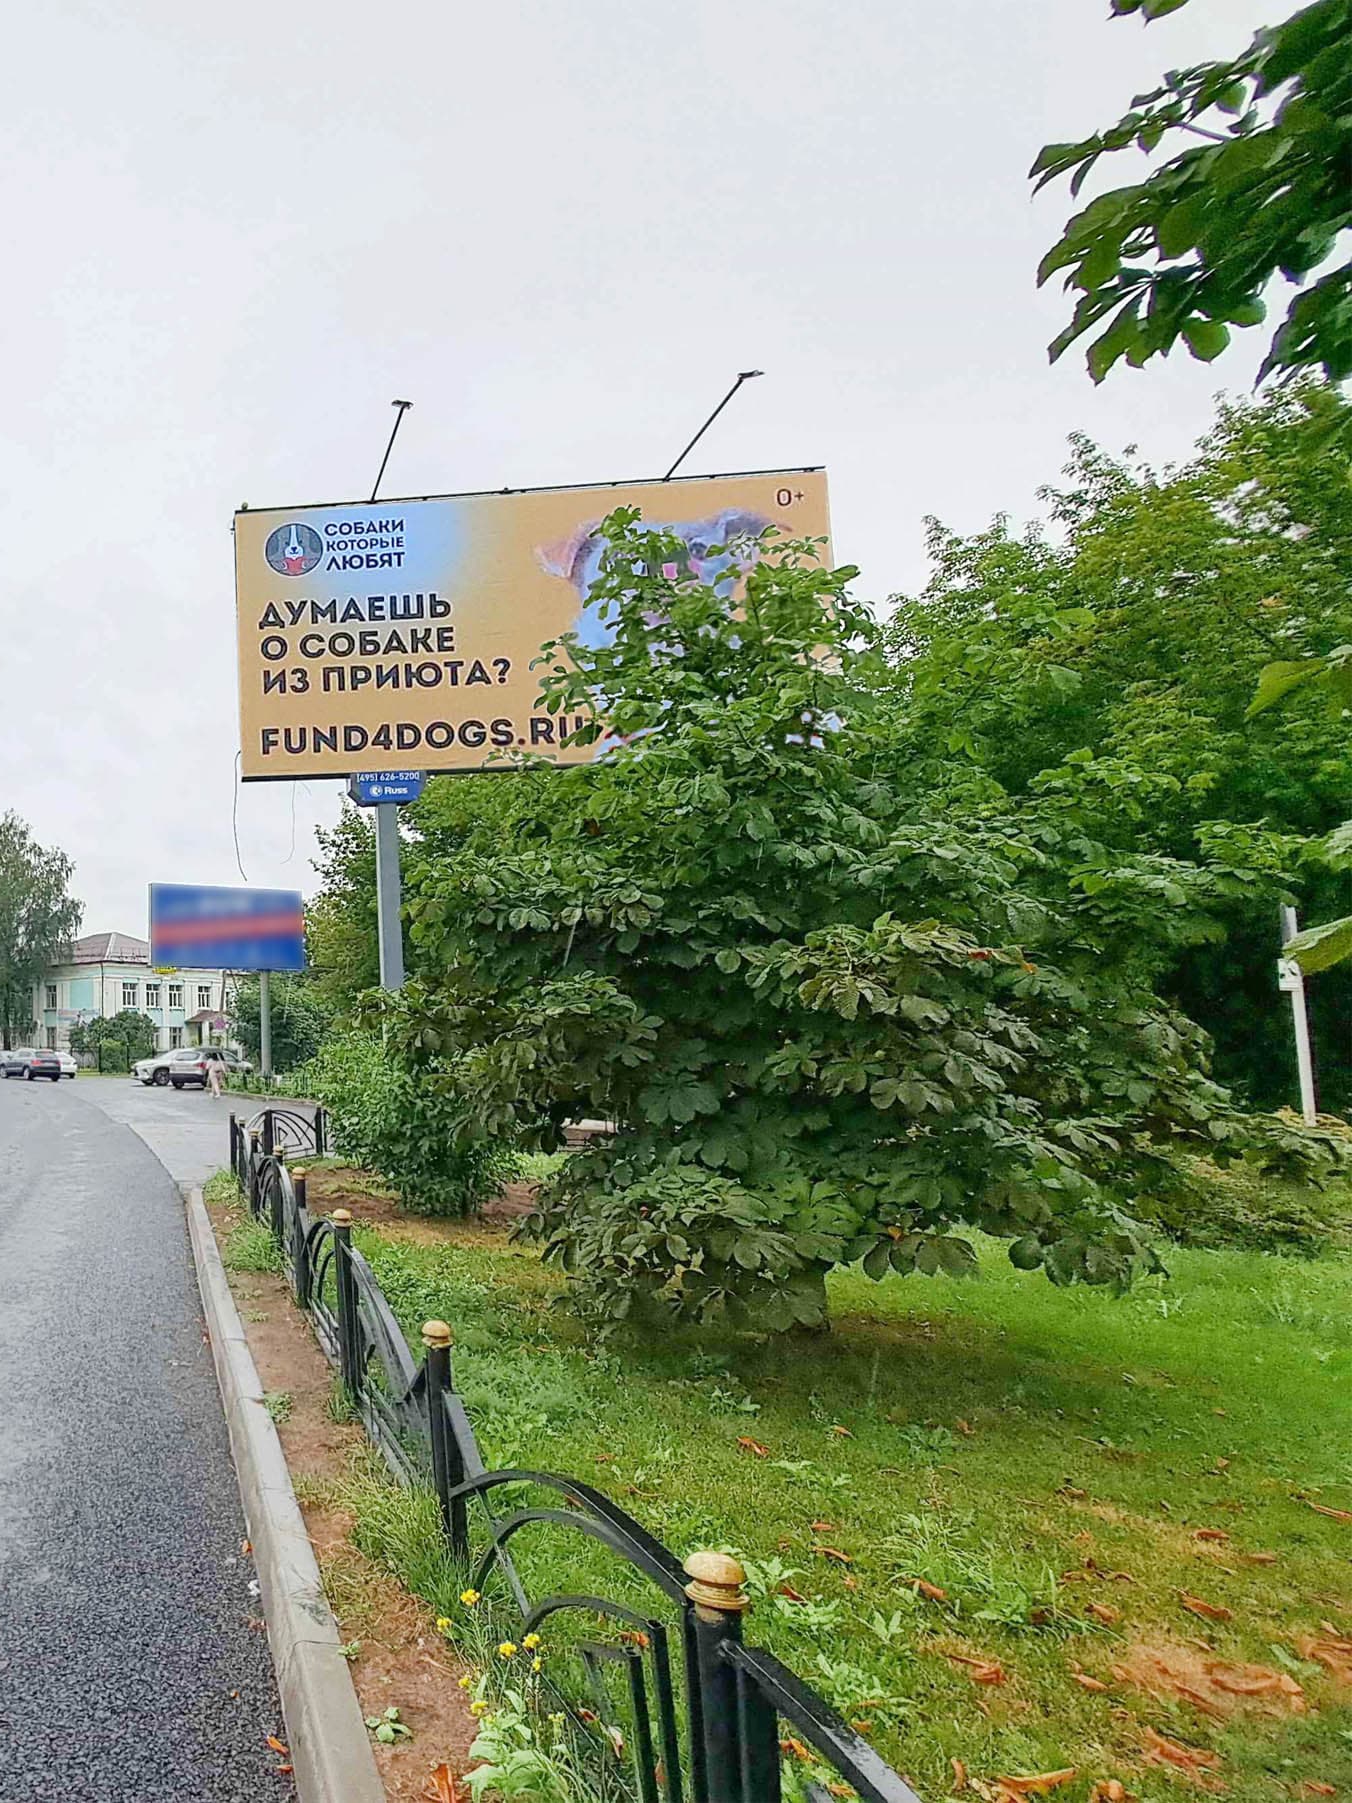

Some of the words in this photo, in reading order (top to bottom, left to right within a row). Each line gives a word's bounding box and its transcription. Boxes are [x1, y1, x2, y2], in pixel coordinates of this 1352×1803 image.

[776, 488, 804, 506] 0+
[324, 518, 405, 537] СОБАКИ
[326, 536, 405, 552] КОТОРЫЕ
[326, 552, 406, 571] ЛЮБЯТ
[258, 593, 452, 630] ДУМАЕШЬ
[260, 635, 288, 660] О
[299, 627, 455, 659] СОБАКЕ
[263, 668, 310, 694] ИЗ
[322, 658, 511, 692] ПРИЮТА?
[384, 786, 408, 795] Russ
